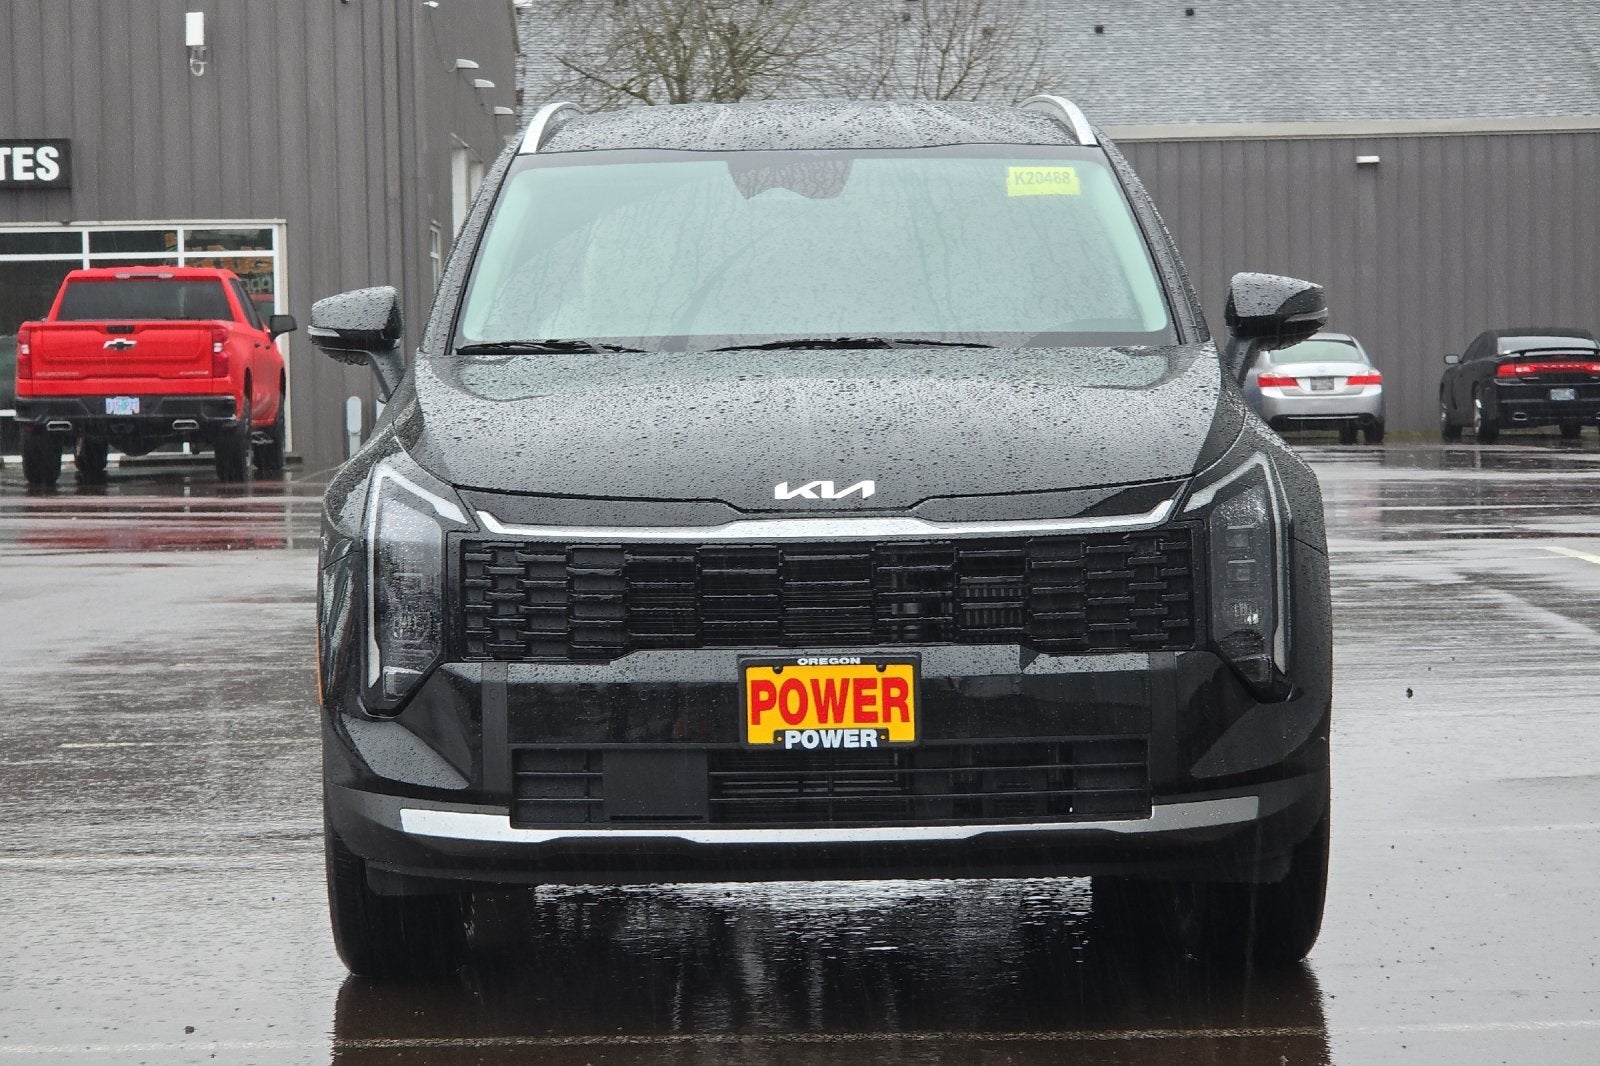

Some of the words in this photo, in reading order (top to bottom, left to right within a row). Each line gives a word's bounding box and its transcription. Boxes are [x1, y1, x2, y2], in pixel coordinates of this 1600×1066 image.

[774, 480, 875, 500] KIA
[797, 657, 861, 666] OREGON
[750, 677, 910, 726] POWER
[785, 729, 878, 750] POWER
